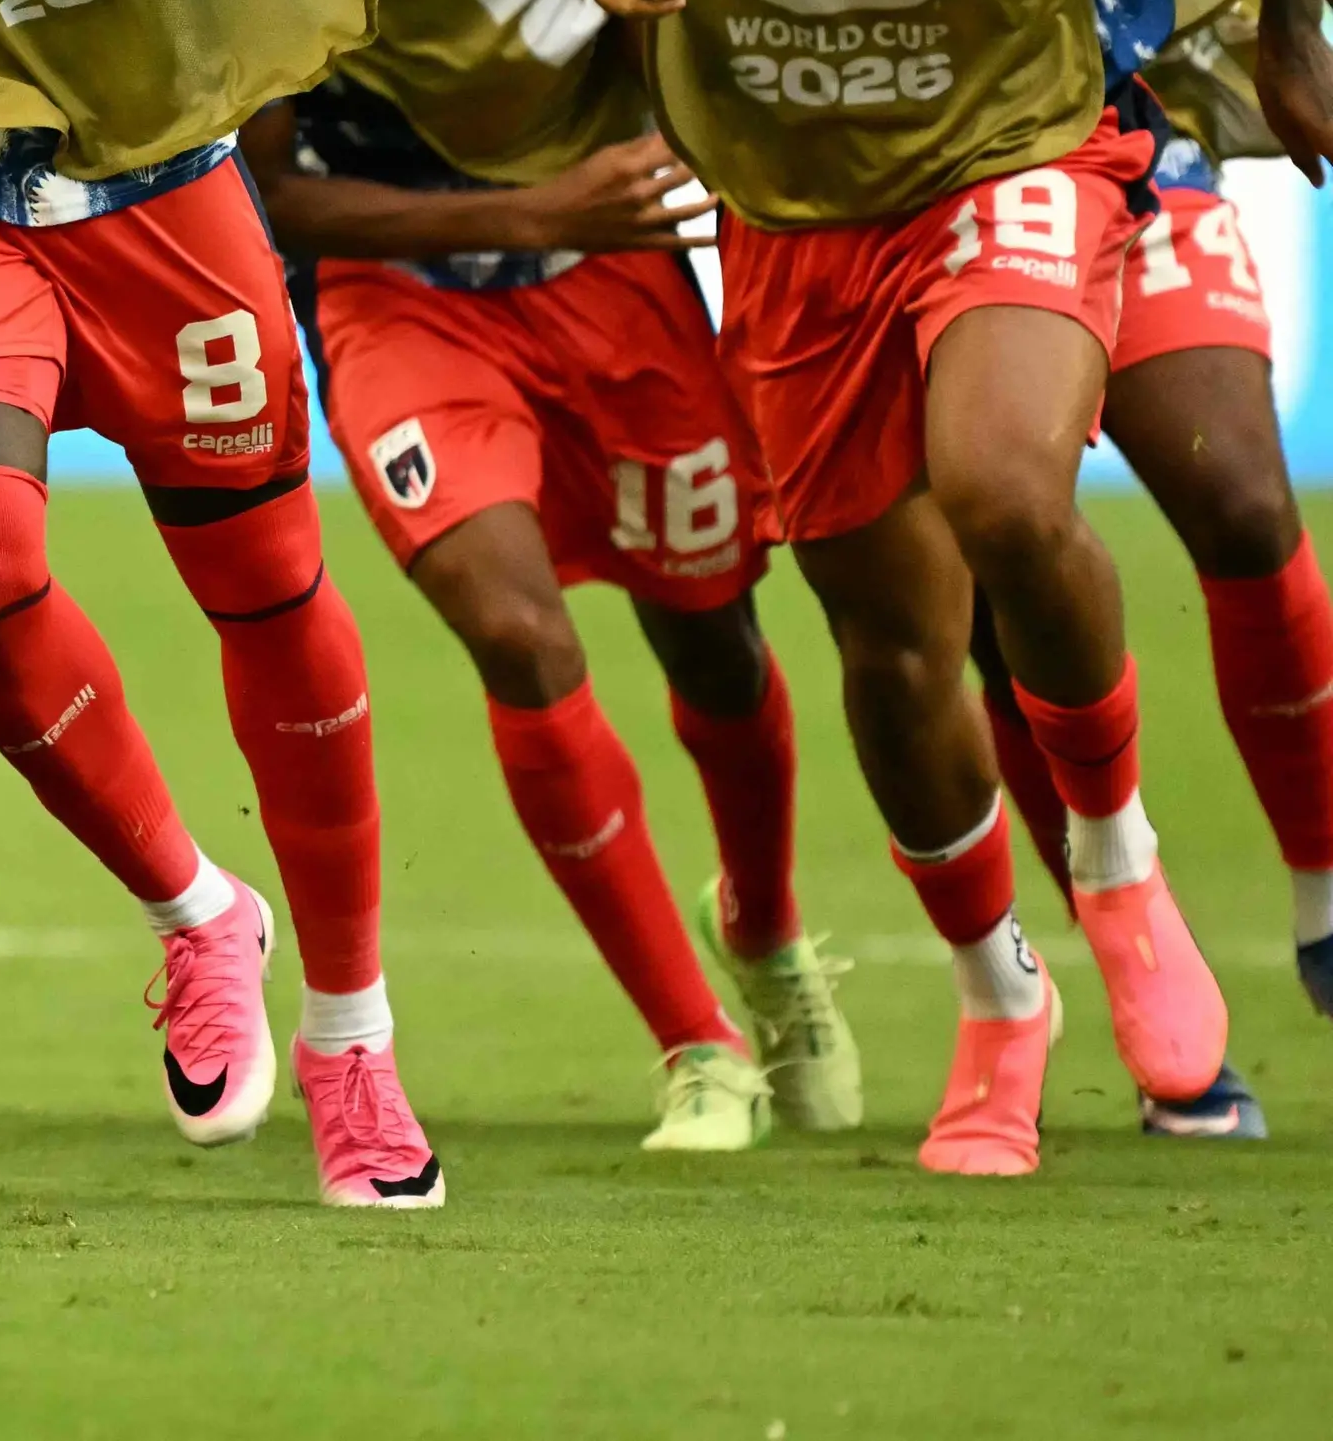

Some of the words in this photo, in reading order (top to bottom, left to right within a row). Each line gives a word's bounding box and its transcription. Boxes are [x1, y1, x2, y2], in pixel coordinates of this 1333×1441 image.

[725, 15, 865, 53] WORLD
[872, 20, 949, 50] CUP
[730, 53, 954, 107] 2026
[944, 168, 1076, 280] 19
[1140, 201, 1260, 297] 14
[176, 309, 267, 423] 8
[183, 422, 273, 454] capelli
[224, 443, 273, 456] SPORT
[610, 438, 738, 553] 16
